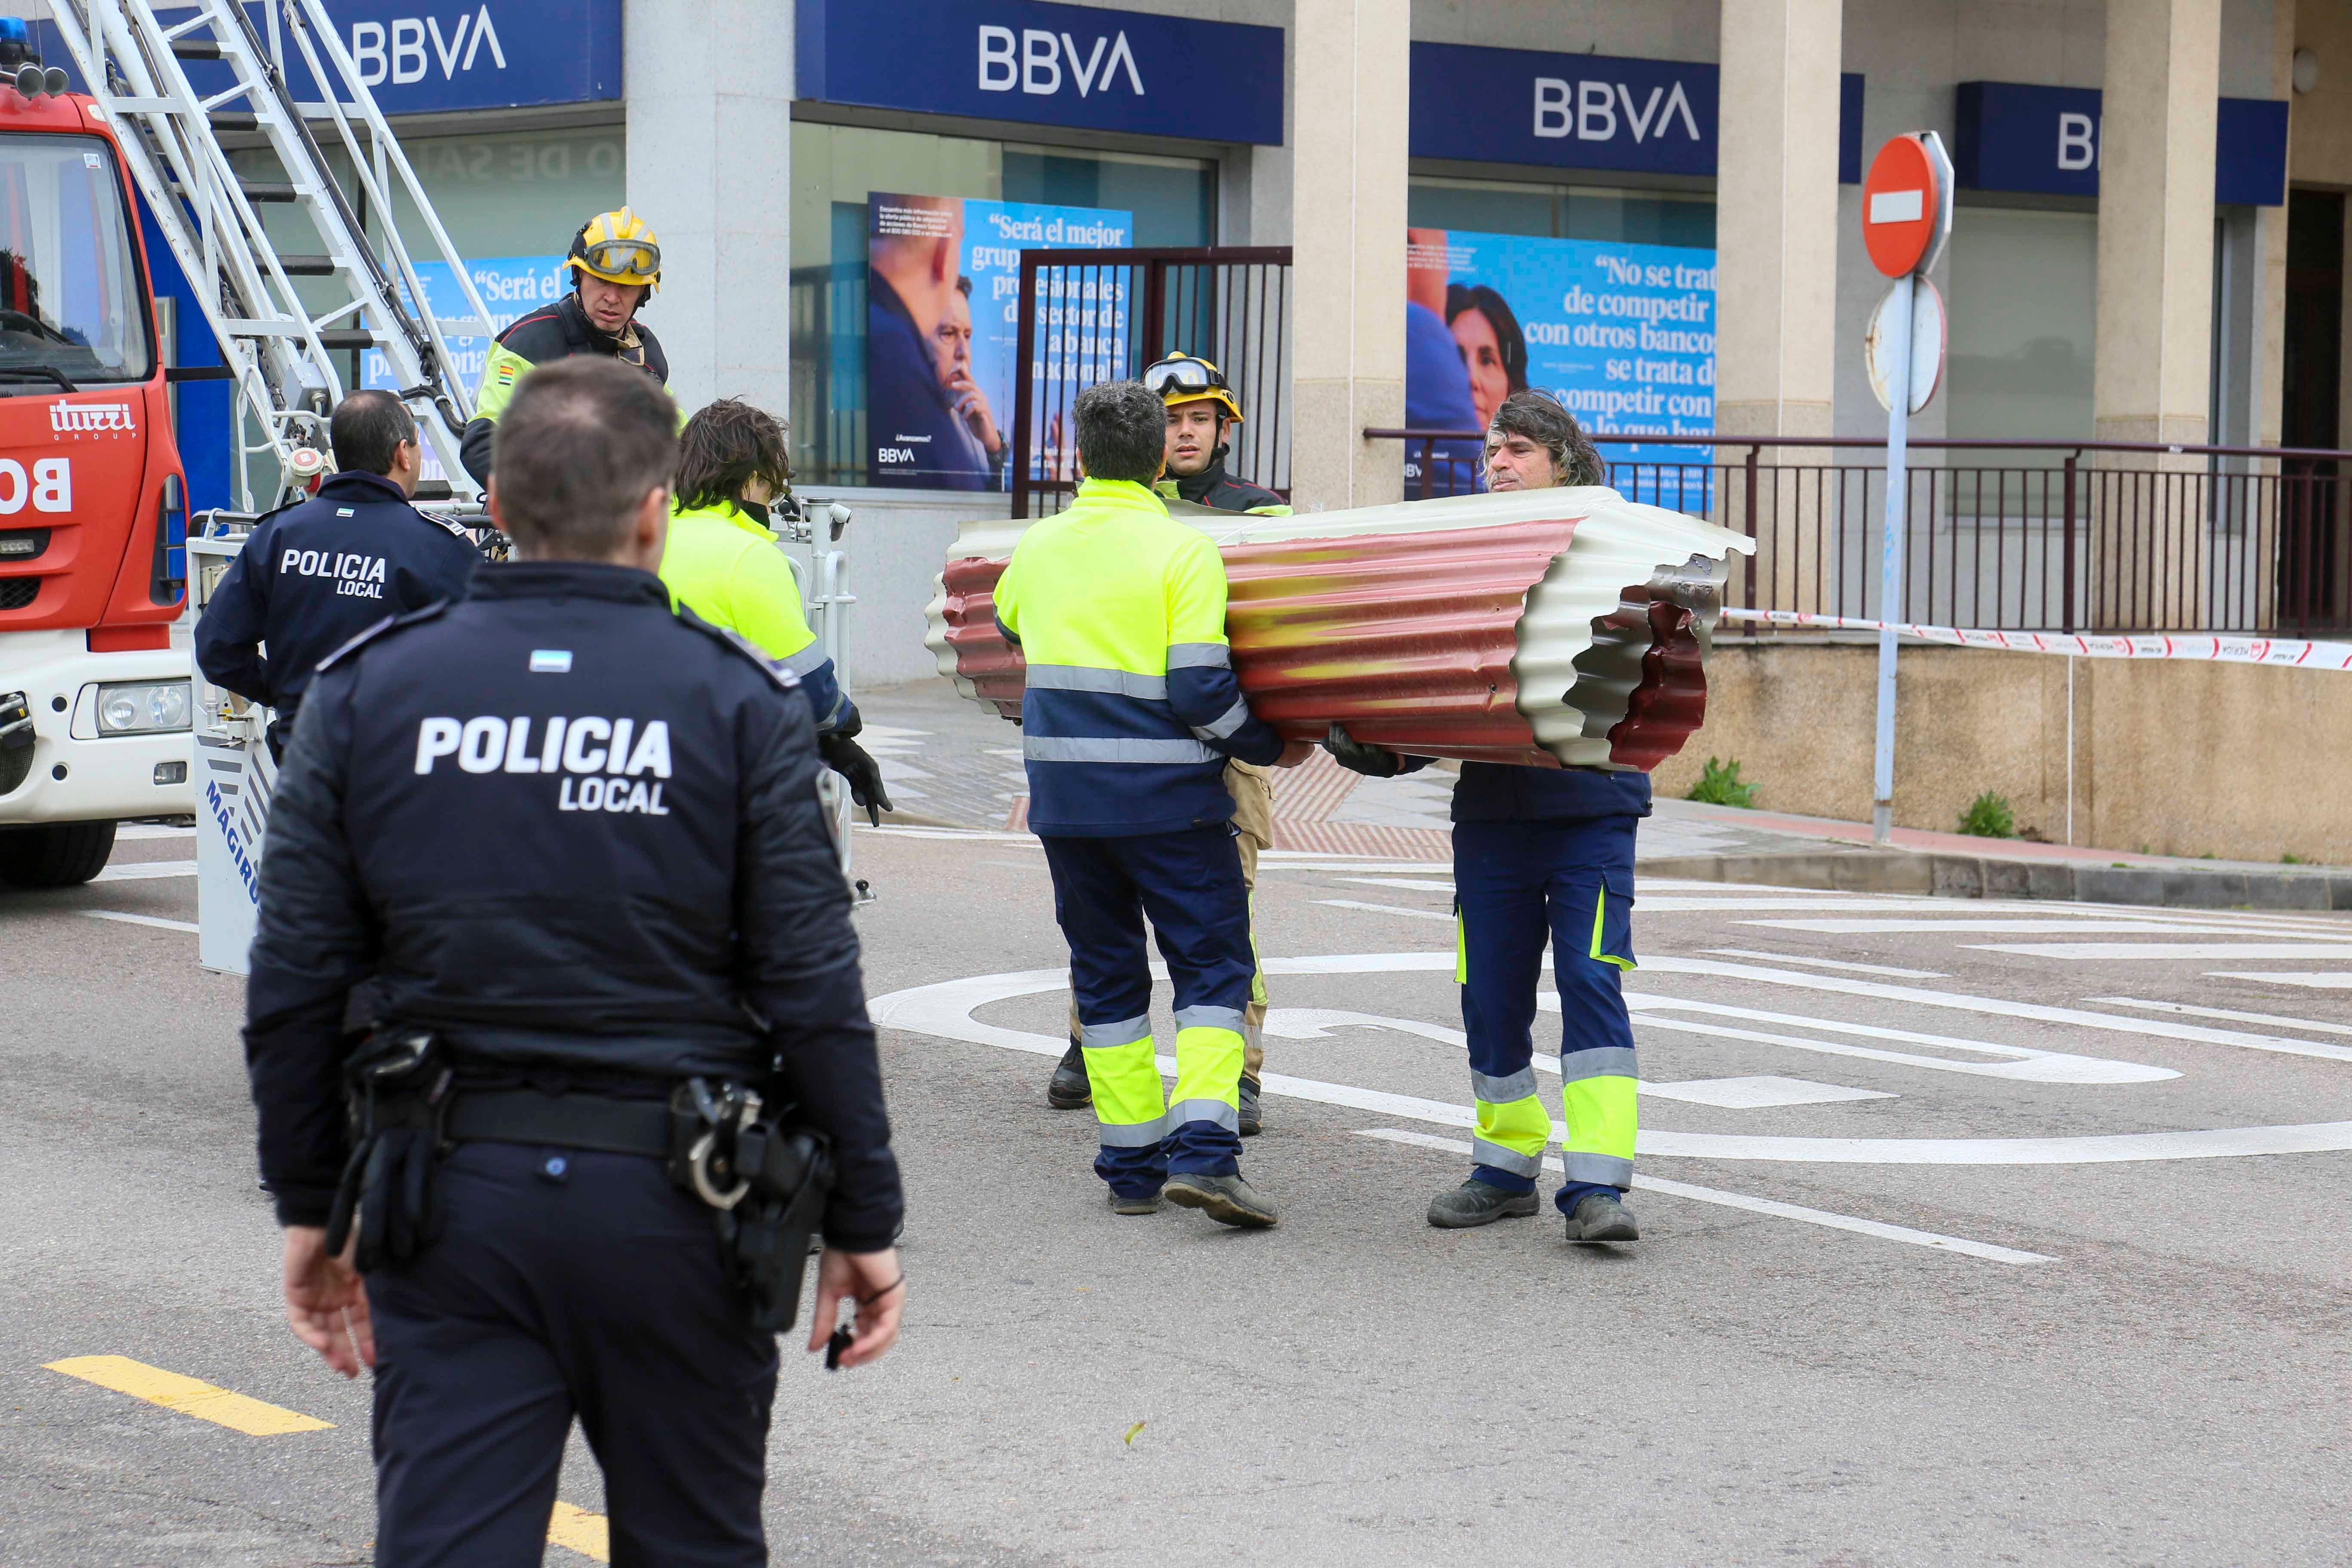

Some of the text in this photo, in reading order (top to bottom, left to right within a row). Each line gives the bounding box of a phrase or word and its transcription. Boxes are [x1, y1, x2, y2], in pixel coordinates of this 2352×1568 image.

[352, 4, 506, 86] BBVA
[979, 24, 1145, 98] BBVA
[1534, 77, 1700, 144] BBVA
[989, 214, 1124, 248] “Será el mejor
[971, 245, 1020, 273] grup
[1595, 254, 1718, 291] “No se trat
[475, 267, 561, 301] “Será el
[1098, 303, 1124, 328] de
[1564, 284, 1709, 326] de competir
[1525, 322, 1717, 354] con otros banco
[1605, 357, 1632, 381] se
[1635, 357, 1694, 385] trata
[1697, 357, 1716, 386] d
[1555, 387, 1712, 419] competir con
[879, 447, 915, 463] BBVA
[280, 549, 386, 583] POLICIA
[337, 580, 383, 599] LOCAL
[414, 716, 672, 778] POLICIA
[559, 777, 670, 815] LOCAL
[206, 779, 260, 905] MAGIRU
